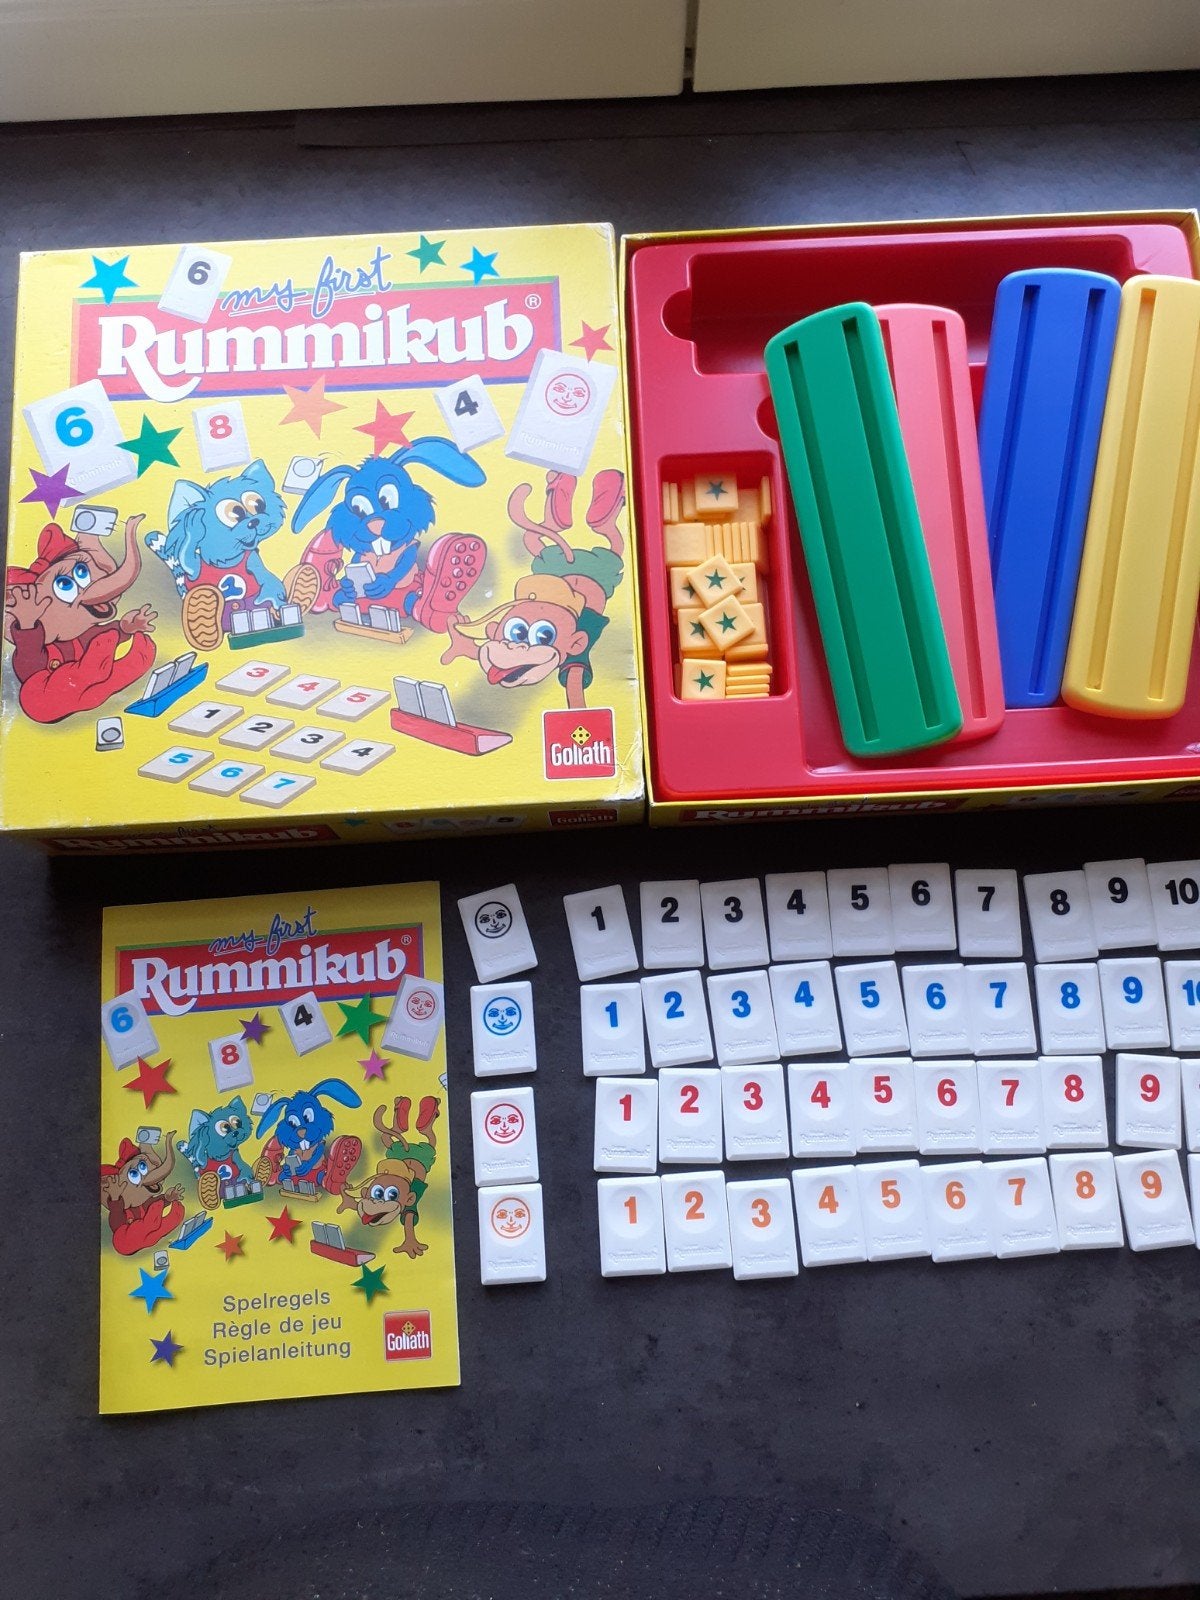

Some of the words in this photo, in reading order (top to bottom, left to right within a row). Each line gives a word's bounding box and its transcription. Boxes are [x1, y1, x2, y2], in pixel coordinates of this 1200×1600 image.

[187, 260, 213, 286] 6
[221, 279, 308, 312] my
[312, 246, 392, 317] first
[453, 389, 480, 417] 4
[54, 406, 94, 448] 6
[209, 416, 231, 439] 8
[245, 666, 270, 681] 3
[297, 680, 321, 694] 4
[347, 691, 372, 705] 5
[203, 708, 222, 719] 1
[252, 722, 274, 734] 2
[300, 733, 323, 744] 3
[168, 752, 193, 765] 5
[350, 746, 374, 757] 4
[551, 740, 611, 767] Goliath
[220, 767, 243, 778] 6
[274, 778, 295, 789] 7
[590, 905, 606, 931] 1
[660, 896, 680, 923] 2
[723, 895, 744, 923] 3
[786, 888, 807, 915] 4
[850, 883, 870, 911] 5
[910, 879, 931, 906] 6
[977, 885, 996, 912] 7
[1049, 888, 1071, 916] 8
[1107, 876, 1129, 904] 9
[1165, 877, 1199, 905] 10
[208, 929, 263, 952] my
[266, 905, 317, 956] first
[604, 1000, 619, 1029] 1
[663, 990, 685, 1020] 2
[730, 989, 752, 1019] 3
[793, 980, 815, 1008] 4
[859, 980, 881, 1009] 5
[925, 982, 947, 1011] 6
[988, 981, 1008, 1009] 7
[1060, 981, 1081, 1010] 8
[1122, 975, 1144, 1005] 9
[109, 1005, 135, 1035] 6
[294, 1004, 313, 1027] 4
[221, 1044, 240, 1065] 8
[619, 1094, 632, 1121] 1
[680, 1085, 699, 1113] 2
[744, 1081, 763, 1111] 3
[811, 1081, 830, 1108] 4
[874, 1076, 893, 1104] 5
[937, 1079, 957, 1107] 6
[1002, 1079, 1019, 1106] 7
[1064, 1074, 1084, 1102] 8
[1140, 1074, 1160, 1102] 9
[624, 1197, 637, 1224] 1
[685, 1191, 704, 1220] 2
[752, 1198, 771, 1228] 3
[819, 1186, 838, 1213] 4
[881, 1180, 900, 1208] 5
[945, 1181, 965, 1209] 6
[1008, 1178, 1025, 1205] 7
[1075, 1170, 1095, 1199] 8
[1141, 1170, 1162, 1199] 9
[222, 1288, 331, 1315] Spelregels
[213, 1319, 272, 1341] Règle
[279, 1316, 304, 1333] de
[312, 1314, 342, 1335] jeu
[387, 1330, 430, 1352] Goliath
[203, 1340, 351, 1368] Spielanleitung
